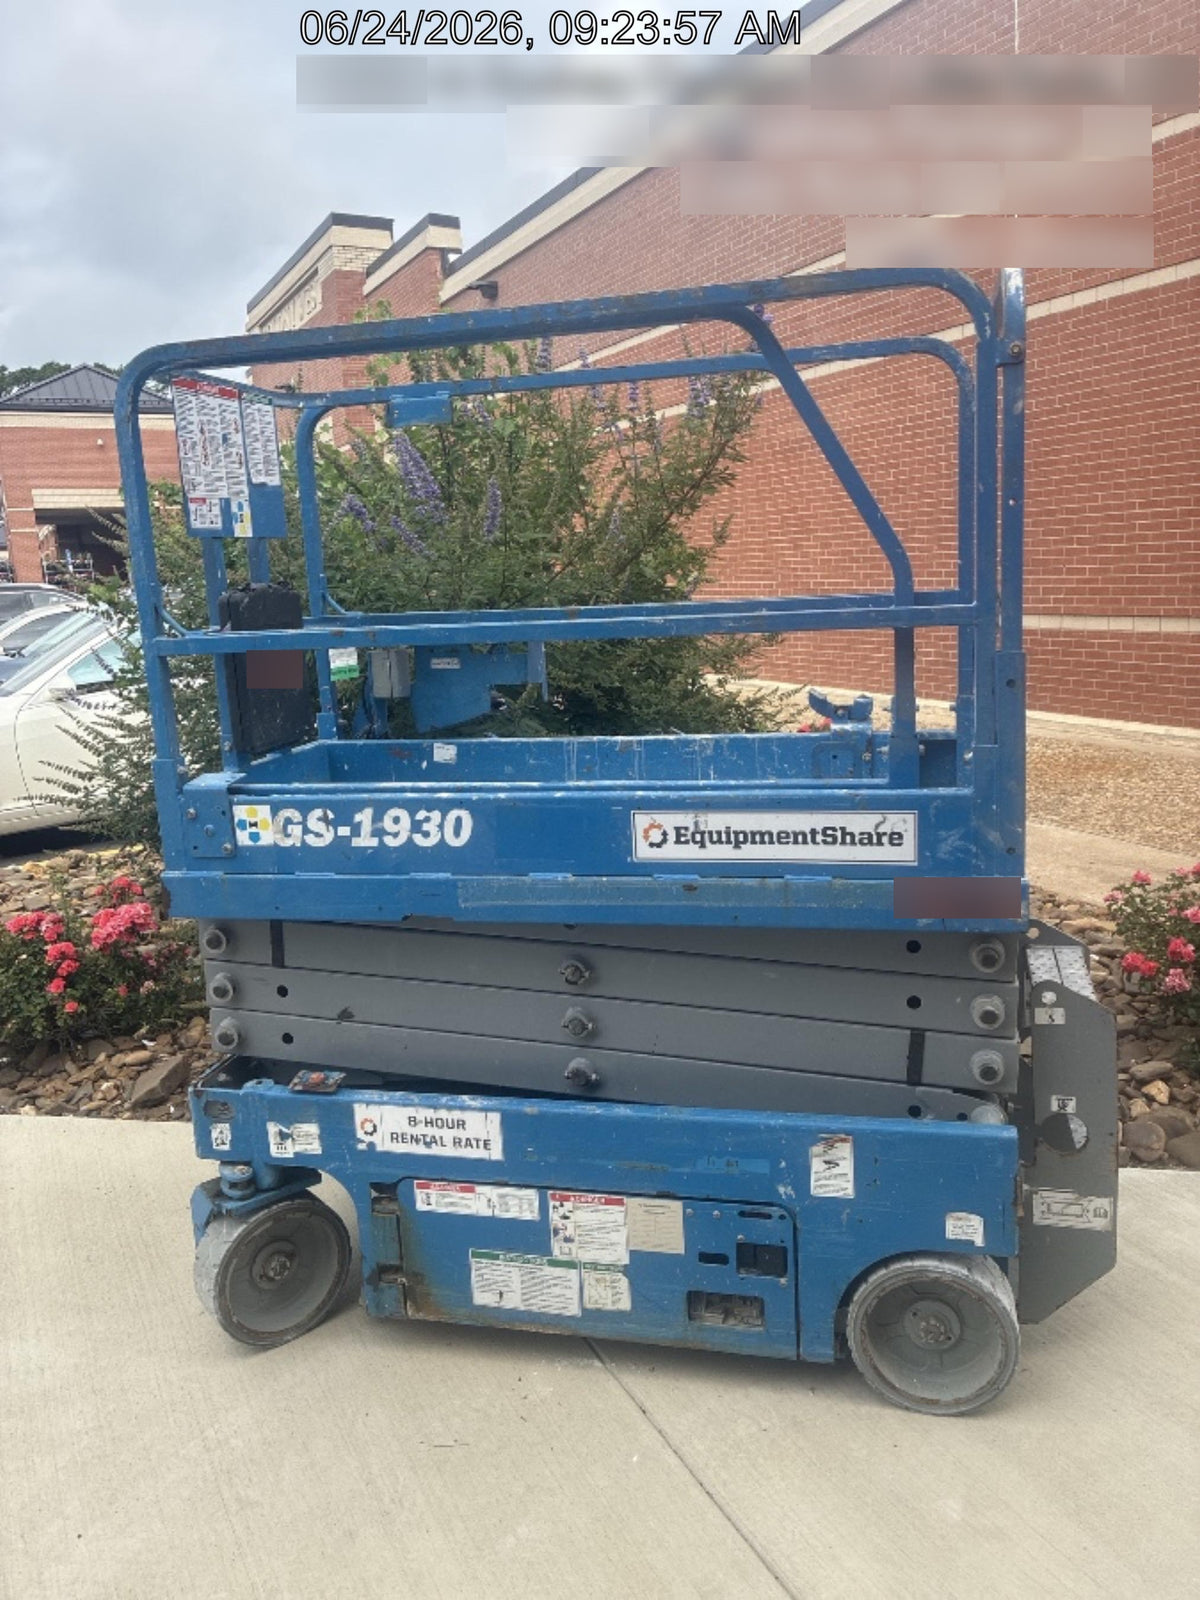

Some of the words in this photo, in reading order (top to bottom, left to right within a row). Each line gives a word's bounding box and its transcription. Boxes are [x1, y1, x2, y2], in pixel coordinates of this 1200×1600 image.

[272, 806, 474, 848] GS-1930
[672, 825, 905, 850] EquipmentShare
[407, 1115, 467, 1131] 8-HOUR
[389, 1131, 448, 1149] RENTAL
[452, 1136, 492, 1151] RATE
